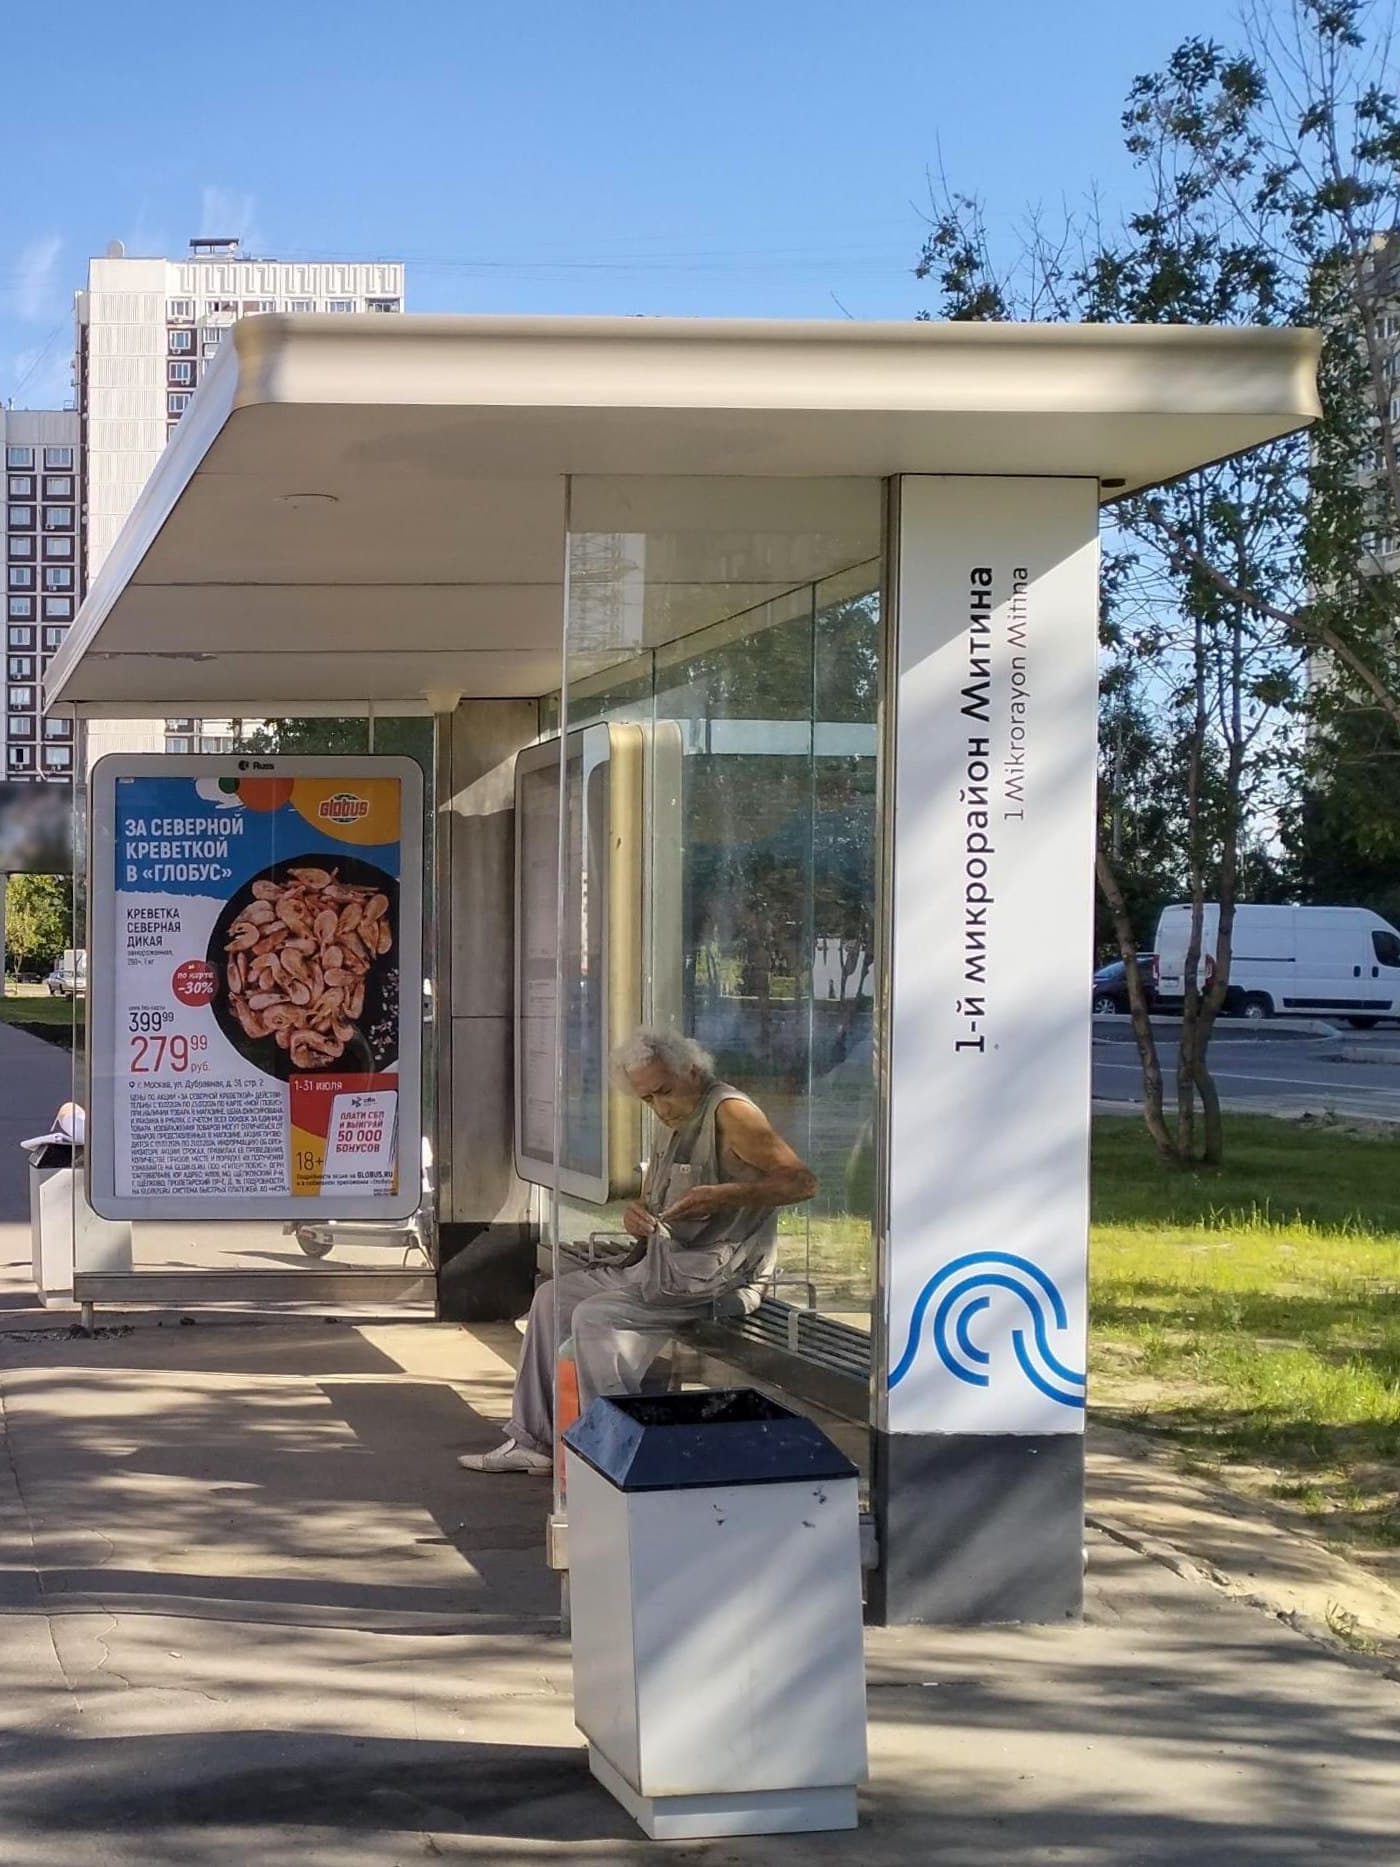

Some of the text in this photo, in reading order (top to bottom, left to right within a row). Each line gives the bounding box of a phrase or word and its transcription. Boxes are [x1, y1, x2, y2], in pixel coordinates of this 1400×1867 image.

[1004, 567, 1031, 820] 1 Mikrorayon Mitina
[955, 567, 995, 1053] 1-й микрорайон Митина
[125, 813, 244, 837] ЗА СЕВЕРНОЙ
[126, 836, 228, 860] КРЕВЕТКОЙ
[126, 863, 232, 882] В «ГЛОБУС»
[127, 907, 181, 919] КРЕВЕТКА
[127, 921, 181, 934] СЕВЕРНАЯ
[127, 935, 163, 948] ДИКАЯ
[294, 1080, 343, 1091] 1-31 июля
[340, 1110, 385, 1120] ПЛАТИ СБП
[338, 1129, 383, 1142] 50 000
[336, 1143, 380, 1153] БОНУСОВ
[296, 1151, 324, 1171] 18+
